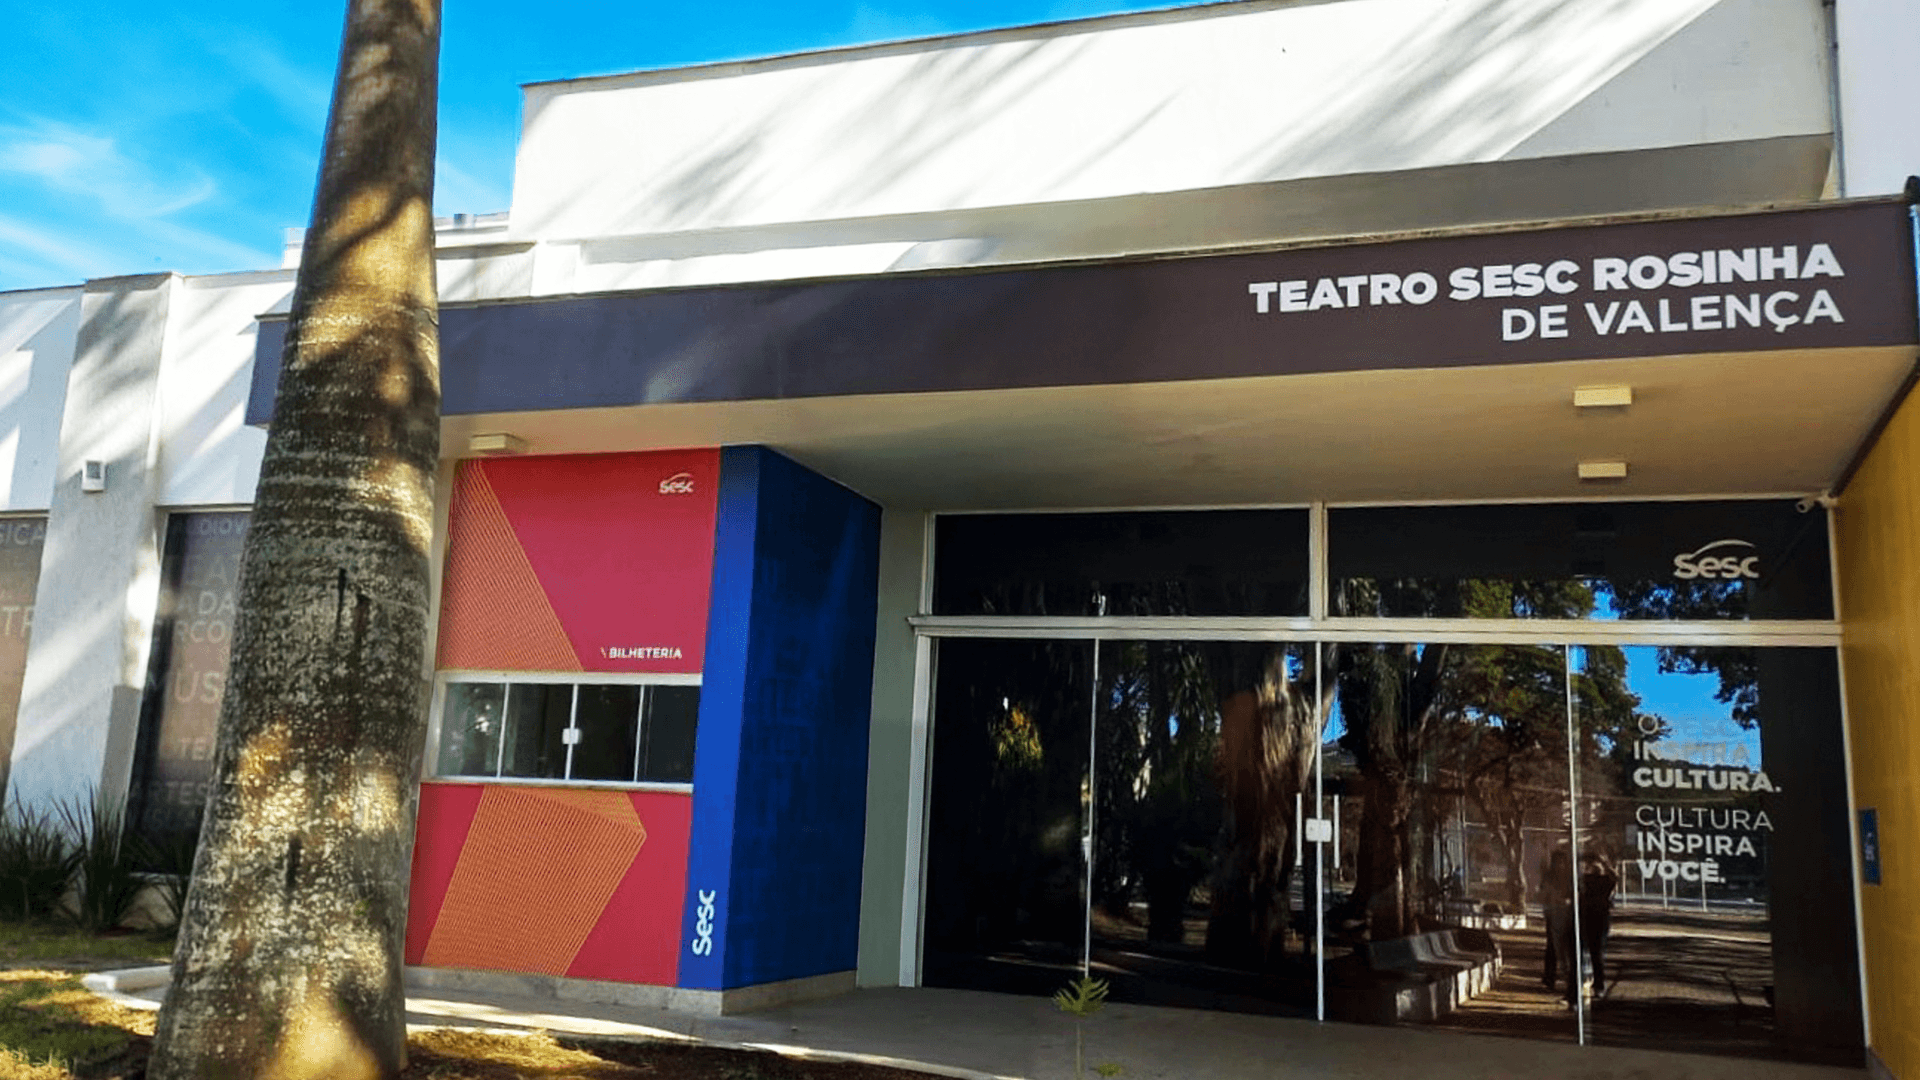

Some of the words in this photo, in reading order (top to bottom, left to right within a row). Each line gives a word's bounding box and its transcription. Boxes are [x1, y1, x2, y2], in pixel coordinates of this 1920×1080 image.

[1249, 272, 1438, 314] TEATRO
[1449, 260, 1579, 301] SESC
[1593, 243, 1845, 293] ROSINHA
[1501, 305, 1569, 343] DE
[1584, 289, 1845, 335] VALENÇA
[608, 646, 683, 660] BILHETERIA
[1637, 714, 1659, 735] O
[1633, 767, 1782, 793] CULTURA.
[1635, 805, 1774, 831] CULTURA
[1637, 831, 1757, 858] INSPIRA
[1637, 858, 1727, 884] VOCÊ.
